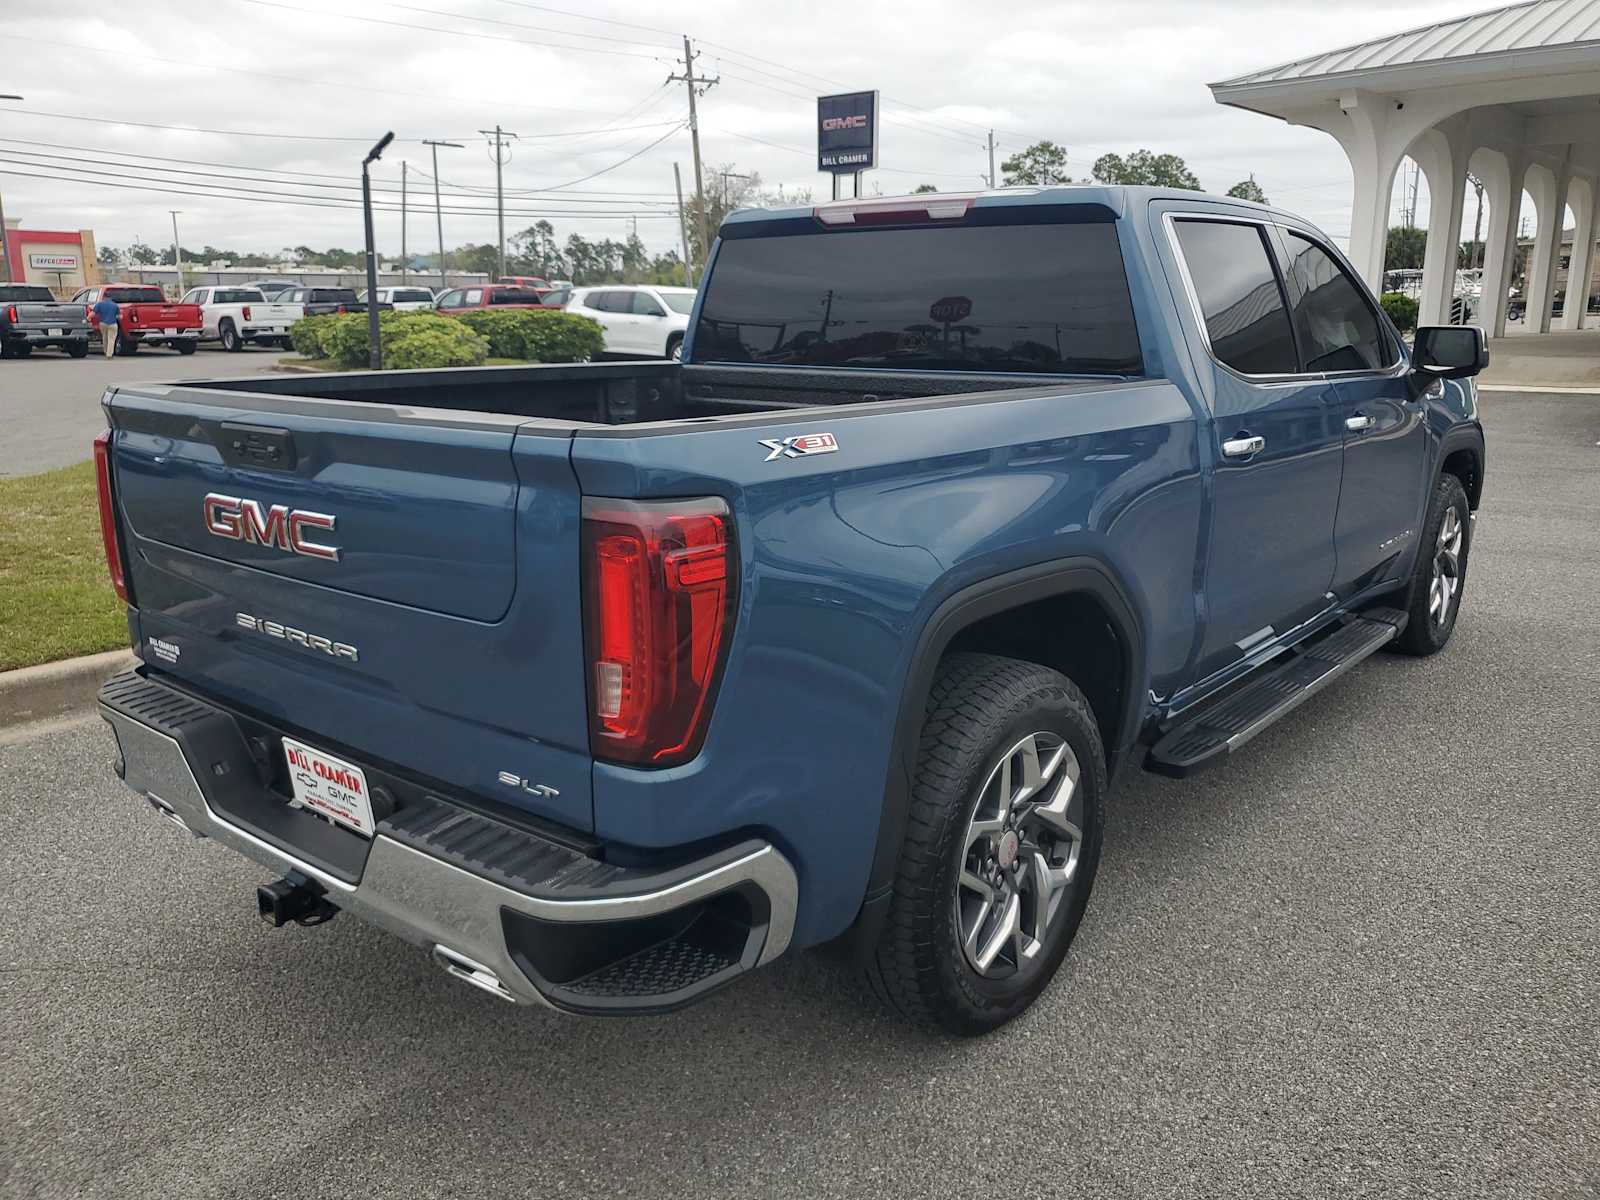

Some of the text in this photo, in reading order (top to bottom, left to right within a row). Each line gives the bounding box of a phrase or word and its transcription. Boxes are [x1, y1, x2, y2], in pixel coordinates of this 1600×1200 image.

[823, 114, 867, 131] GMC
[822, 154, 868, 166] BILL CRAMER
[204, 492, 341, 562] GMC
[236, 612, 359, 662] SIERRA
[287, 748, 362, 795] BILL CRAMER
[498, 771, 560, 797] SLT
[328, 786, 358, 808] GMC
